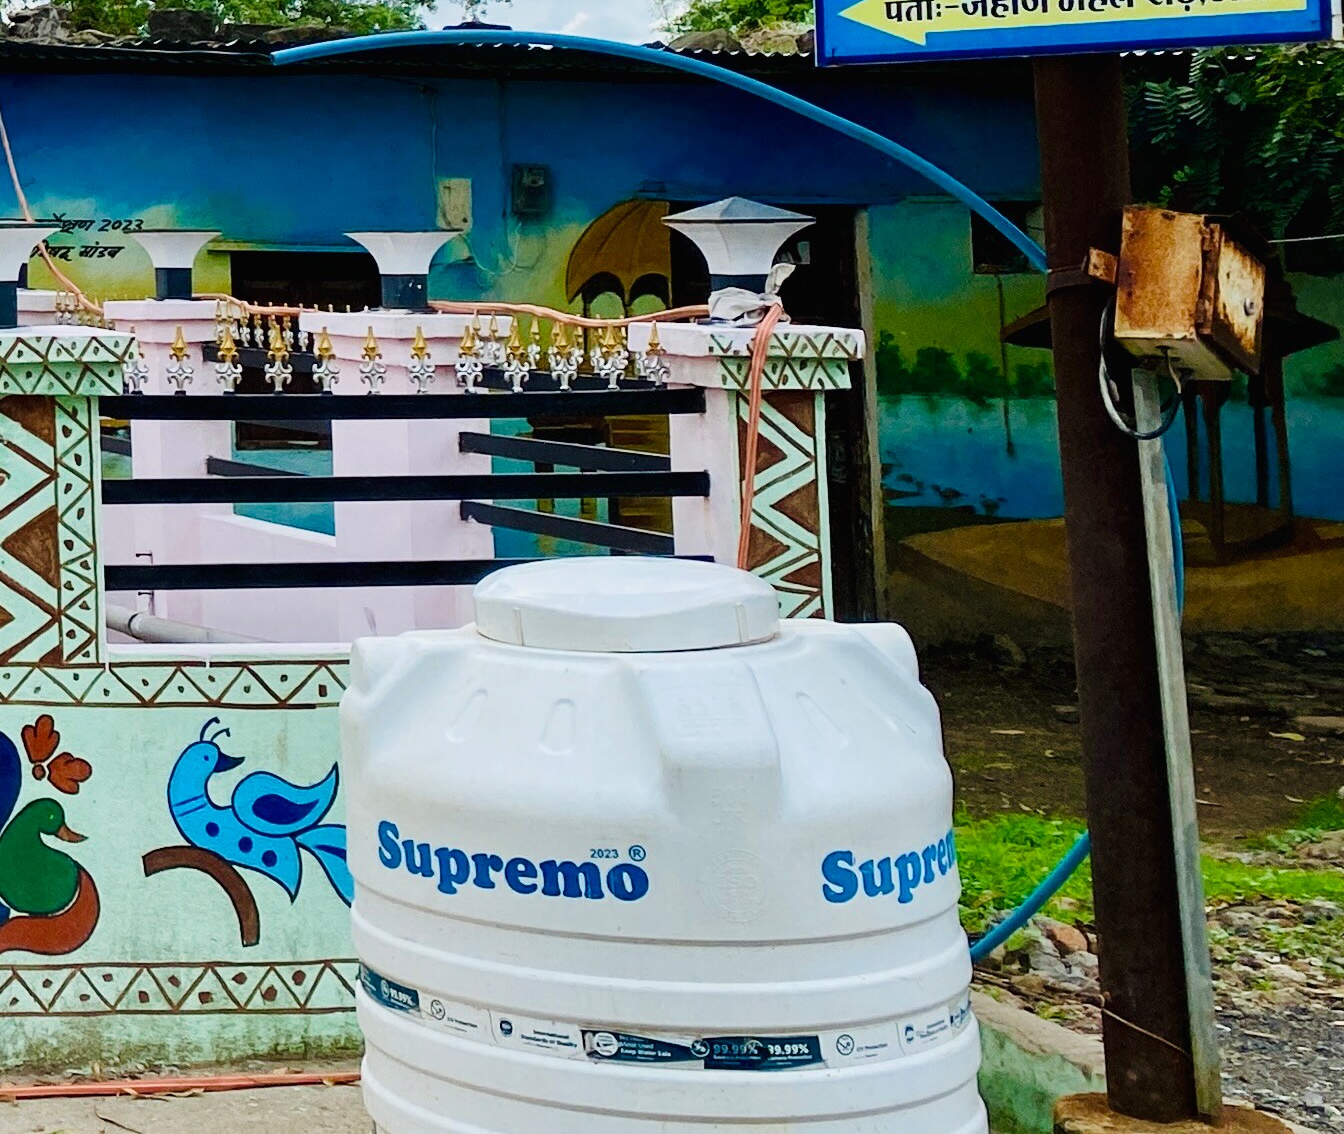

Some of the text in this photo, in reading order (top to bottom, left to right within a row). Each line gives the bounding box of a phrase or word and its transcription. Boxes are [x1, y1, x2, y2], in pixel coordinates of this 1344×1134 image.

[98, 219, 144, 233] 2023
[377, 819, 650, 902] Supremo
[590, 848, 620, 859] 2023
